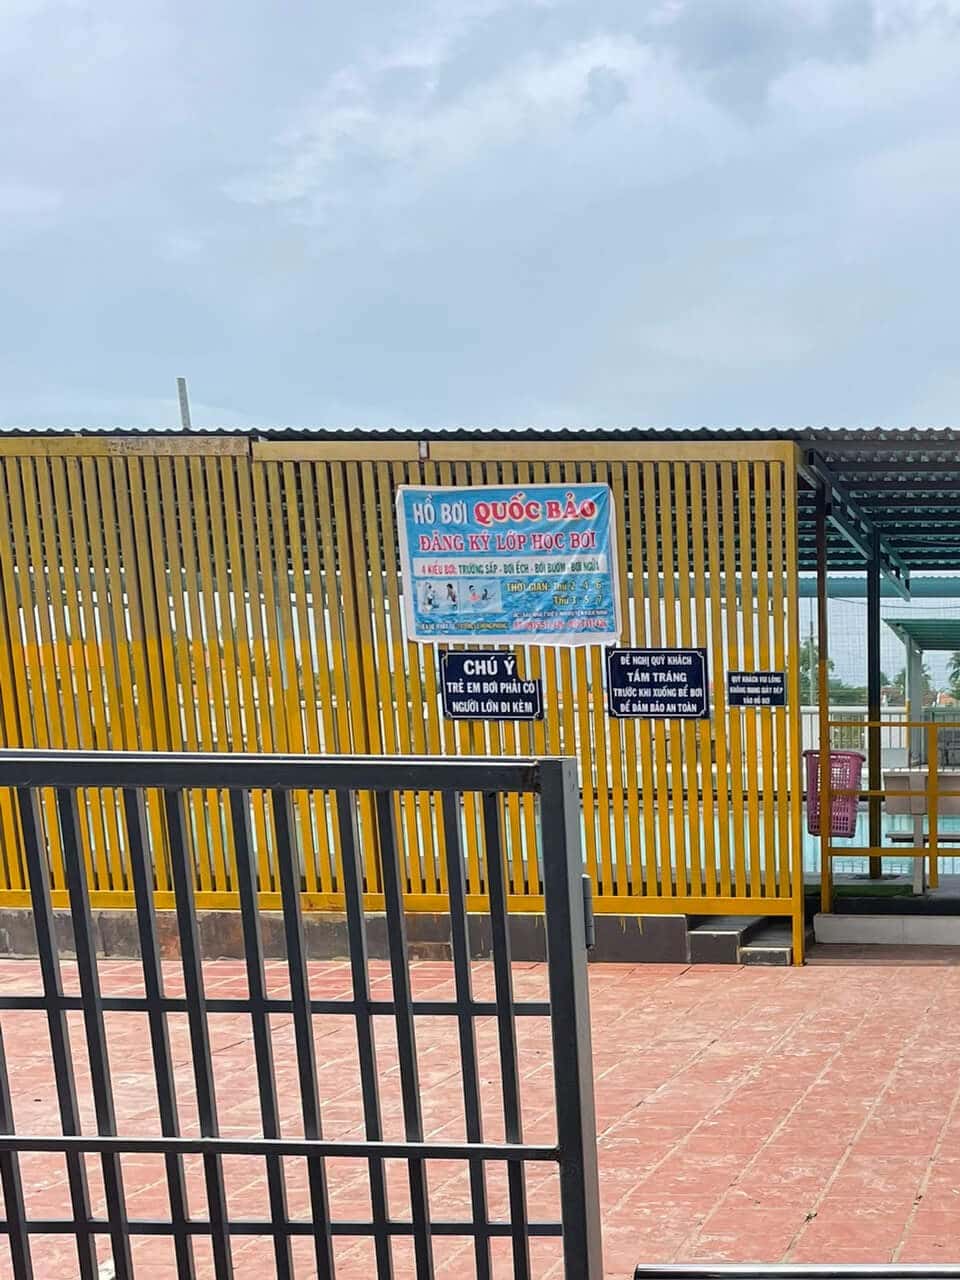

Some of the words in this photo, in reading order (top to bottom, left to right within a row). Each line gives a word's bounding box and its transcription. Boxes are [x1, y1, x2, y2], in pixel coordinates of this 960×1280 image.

[413, 494, 436, 524] HỒ
[441, 499, 469, 524] BƠI
[474, 492, 541, 526] QUỐC
[546, 490, 596, 520] BẢO
[420, 530, 464, 551] ĐĂNG
[468, 530, 490, 551] KÝ
[496, 530, 526, 550] LỚP
[531, 533, 565, 553] HỌC
[570, 529, 597, 549] BƠI
[463, 656, 498, 675] CHÚ
[504, 656, 515, 675] Ý
[632, 656, 650, 667] NGHỊ
[667, 655, 692, 665] KHÁCH
[653, 670, 687, 682] TRÁNG
[447, 679, 464, 693] TRẺ
[467, 682, 480, 693] EM
[482, 680, 498, 693] BƠI
[500, 679, 521, 693] PHẢI
[639, 688, 651, 697] KHI
[650, 701, 665, 712] BẢO
[666, 703, 677, 712] AN
[678, 701, 697, 712] TOÀN
